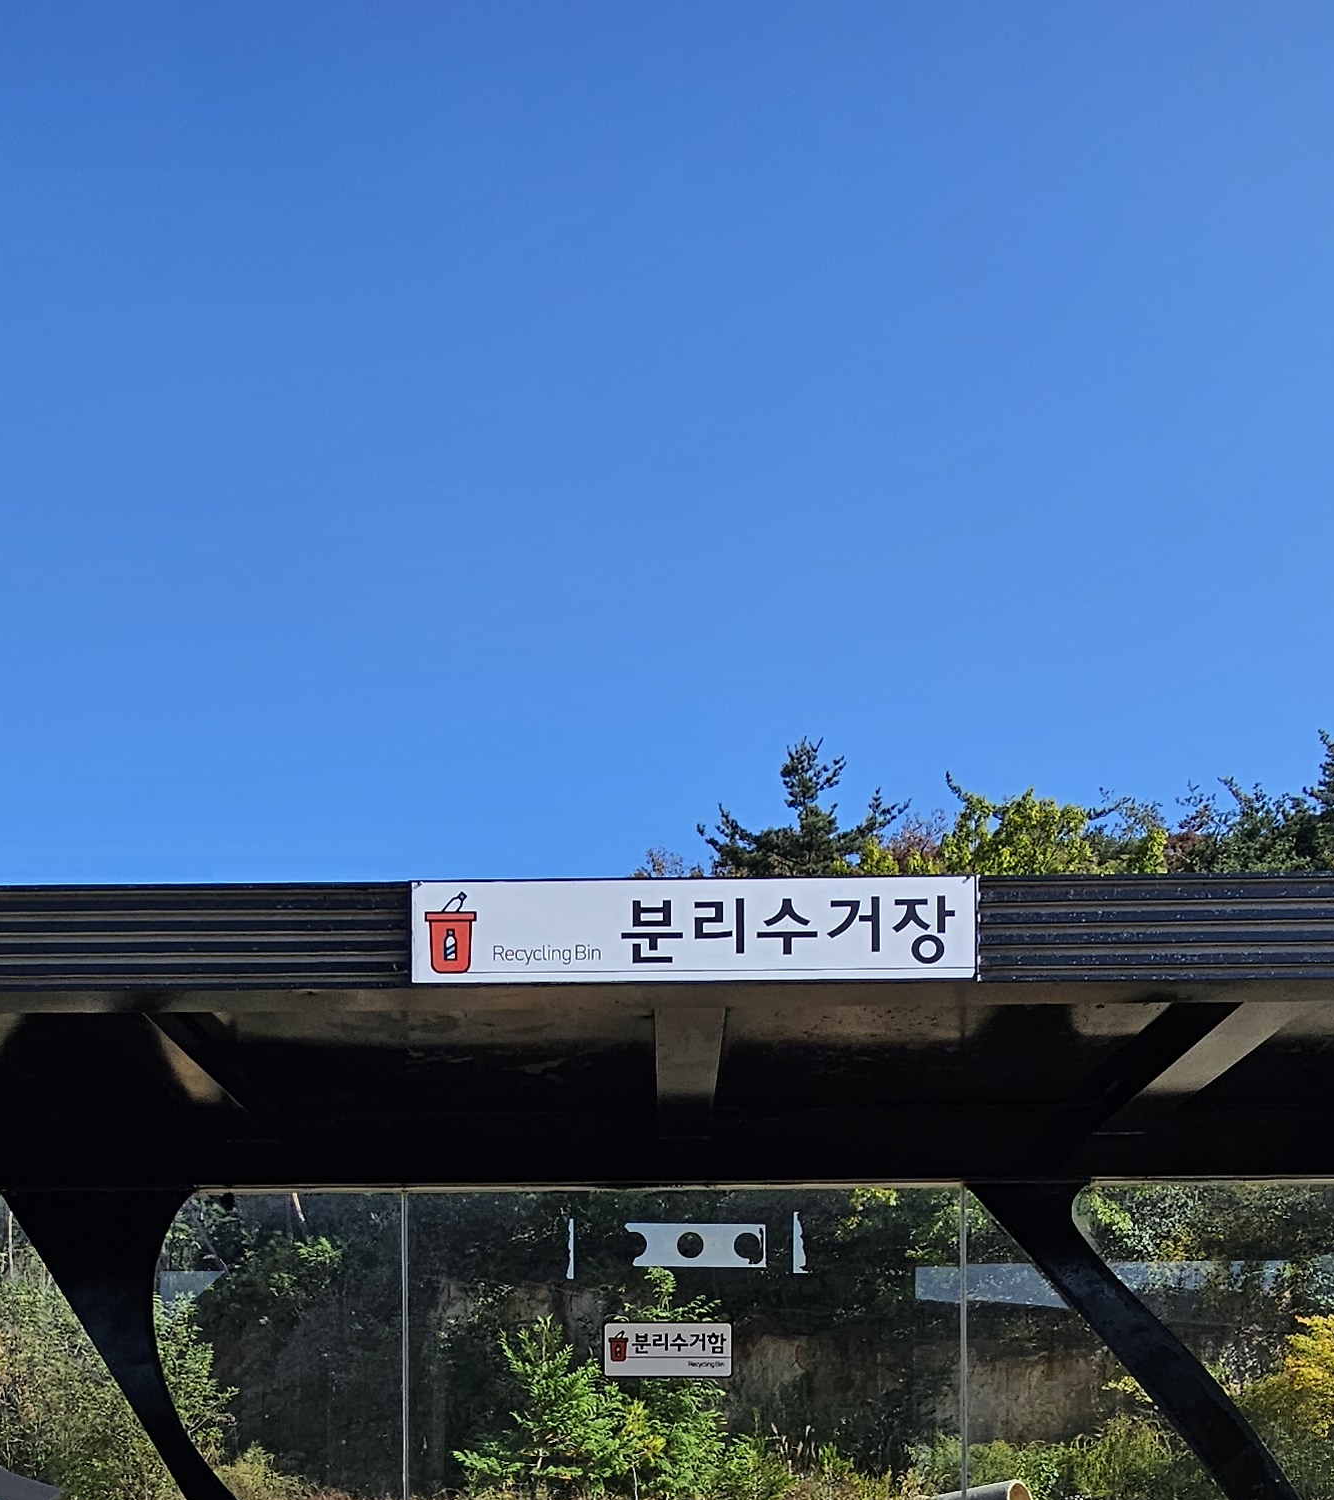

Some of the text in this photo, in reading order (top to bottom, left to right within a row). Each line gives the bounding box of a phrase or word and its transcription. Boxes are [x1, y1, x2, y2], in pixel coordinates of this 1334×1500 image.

[620, 895, 956, 965] 분리수거장
[492, 944, 602, 967] Recycling Bin
[632, 1333, 727, 1354] 분리수거함
